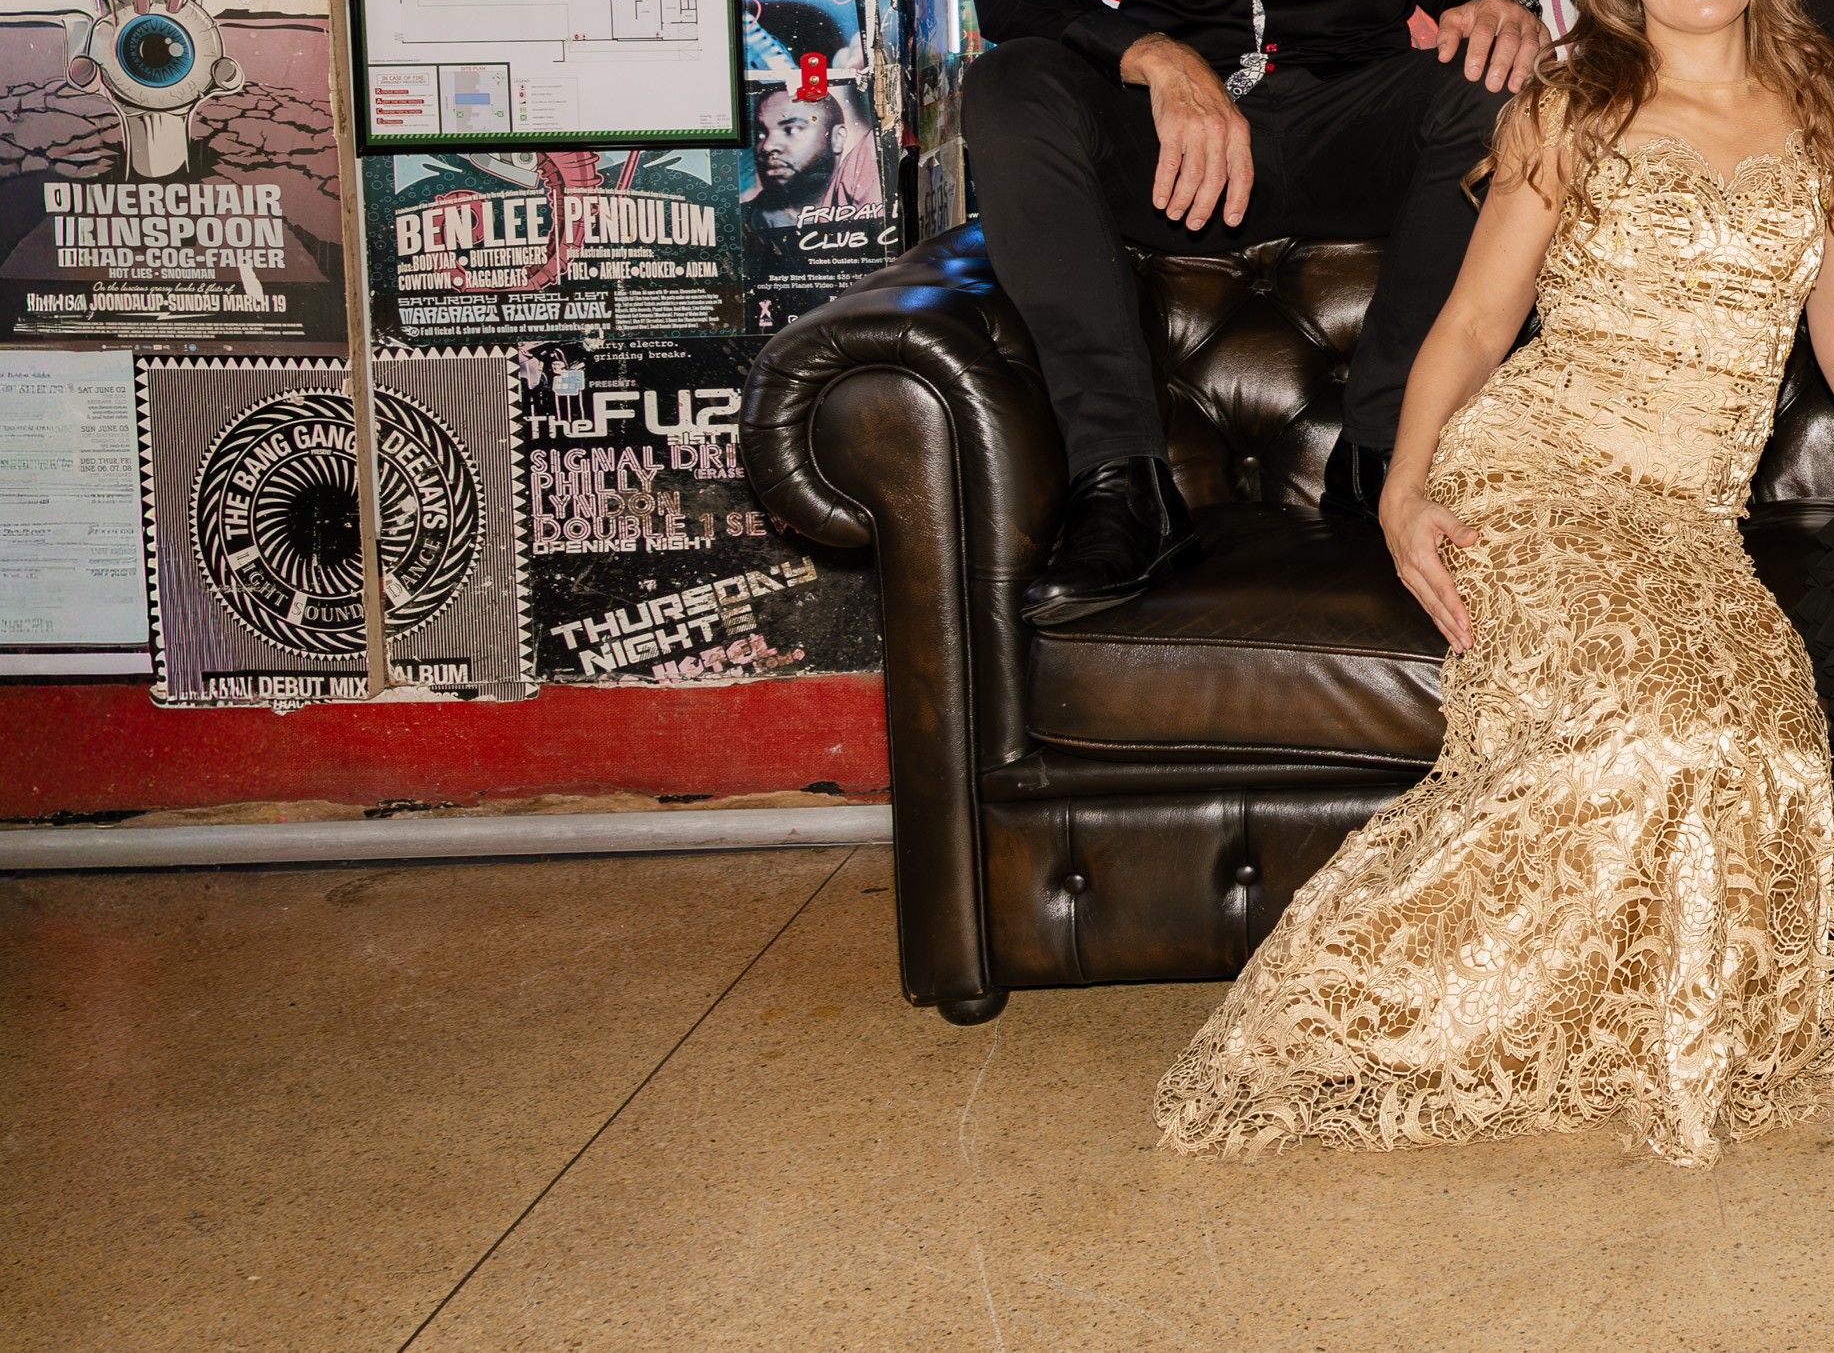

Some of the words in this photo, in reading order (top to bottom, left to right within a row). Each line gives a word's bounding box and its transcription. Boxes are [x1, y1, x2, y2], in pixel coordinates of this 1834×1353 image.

[562, 197, 717, 247] PENDULUM
[797, 202, 883, 228] FRIDAY
[396, 203, 473, 256] BEN
[482, 196, 549, 247] LEE
[799, 231, 868, 251] CLUB
[470, 246, 548, 268] BUTTERFINGERS
[161, 268, 216, 279] SNOWMAN
[465, 269, 528, 288] RAGGABEATS
[168, 295, 220, 312] SUNDAY
[223, 295, 270, 313] MARCH
[272, 295, 287, 313] 19
[398, 294, 498, 306] SATURDAY
[508, 292, 569, 303] APRIL
[502, 302, 561, 323] RIVER
[530, 469, 660, 497] PHILLY
[531, 491, 681, 520] LYNDON
[533, 539, 637, 555] OPENING
[646, 536, 715, 551] NIGHT
[550, 556, 817, 650] THURSDAY
[259, 677, 324, 698] DEBUT
[329, 677, 368, 697] MIX
